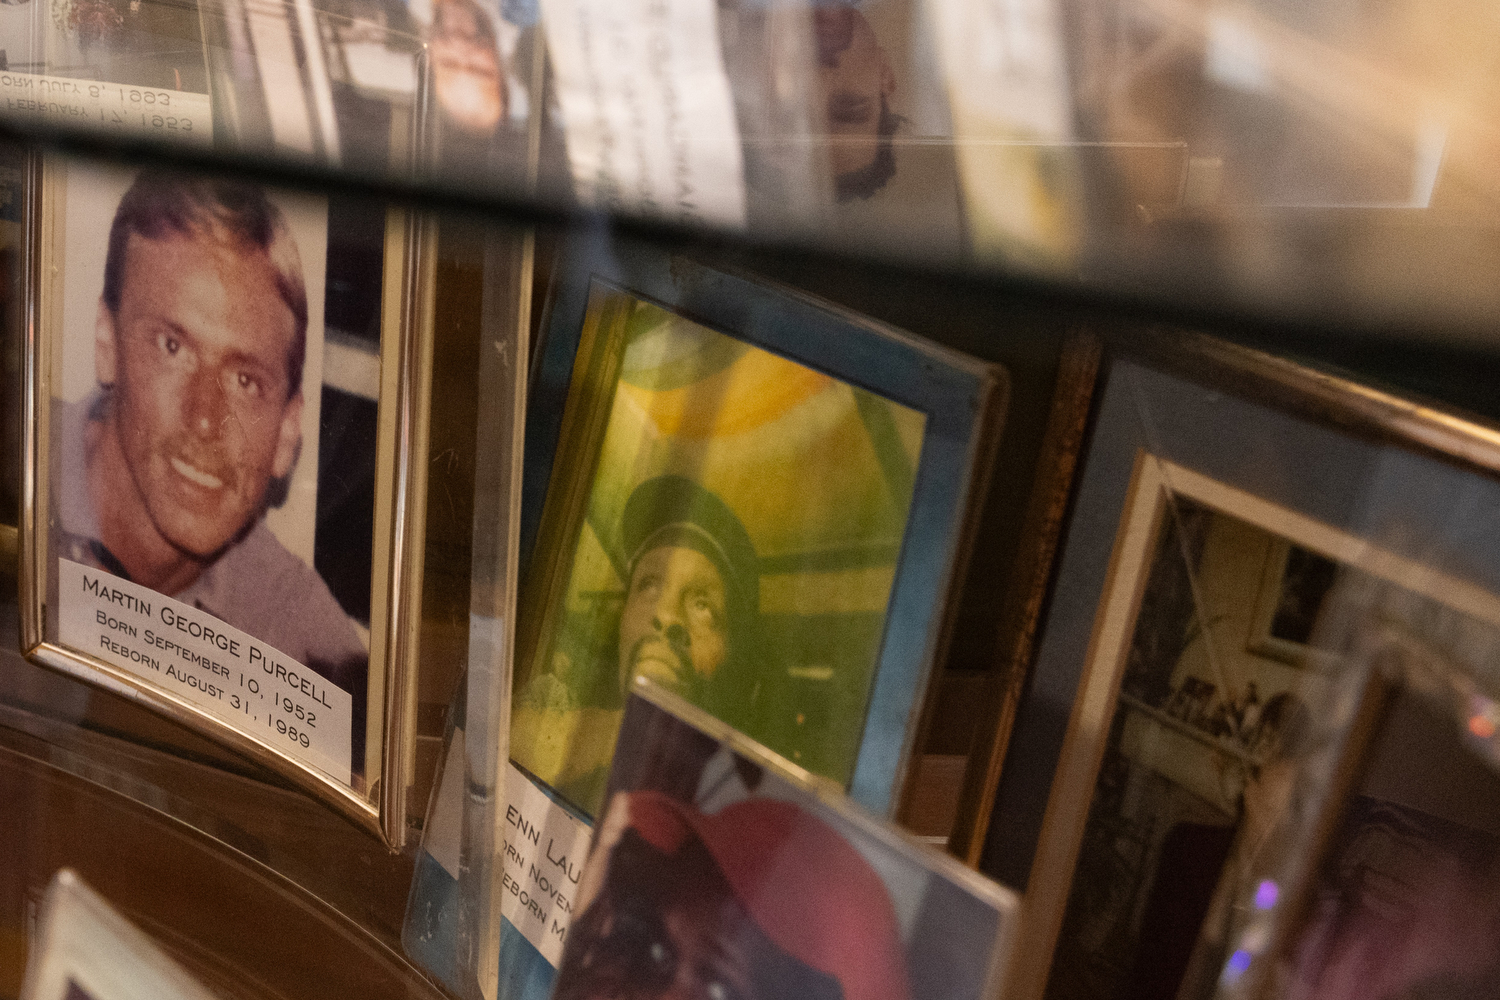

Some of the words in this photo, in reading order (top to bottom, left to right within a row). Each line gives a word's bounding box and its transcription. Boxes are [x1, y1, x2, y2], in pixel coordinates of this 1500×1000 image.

[82, 574, 151, 617] MARTIN
[159, 606, 241, 658] GEORGE
[248, 645, 332, 709] PURCELL
[95, 608, 138, 638] BORN
[143, 628, 230, 680] SEPTEMBER
[239, 672, 264, 699] 10,
[274, 691, 317, 728] 1952
[100, 635, 160, 672] REBORN
[165, 664, 224, 699] AUGUST
[230, 695, 257, 721] 31,
[268, 714, 310, 748] 1989
[502, 868, 547, 924] EBORN
